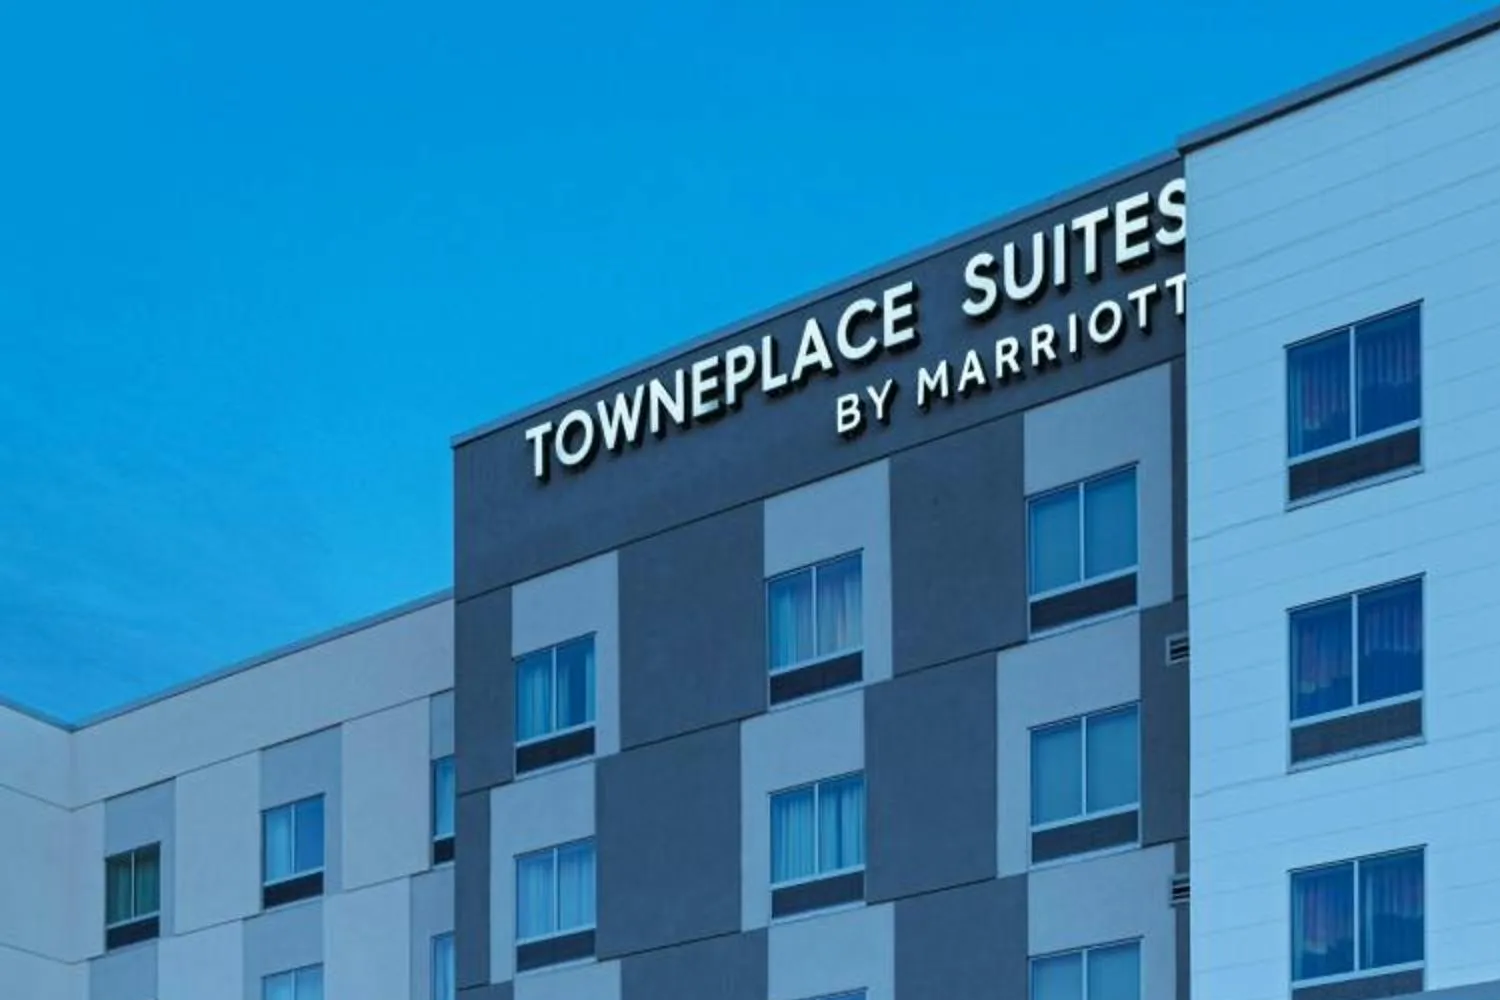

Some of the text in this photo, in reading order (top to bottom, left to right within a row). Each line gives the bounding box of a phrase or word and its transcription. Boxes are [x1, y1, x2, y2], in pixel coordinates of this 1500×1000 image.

[525, 177, 1187, 478] TOWNEPLACE SUITES
[836, 272, 1187, 434] BY MARRIOTT
